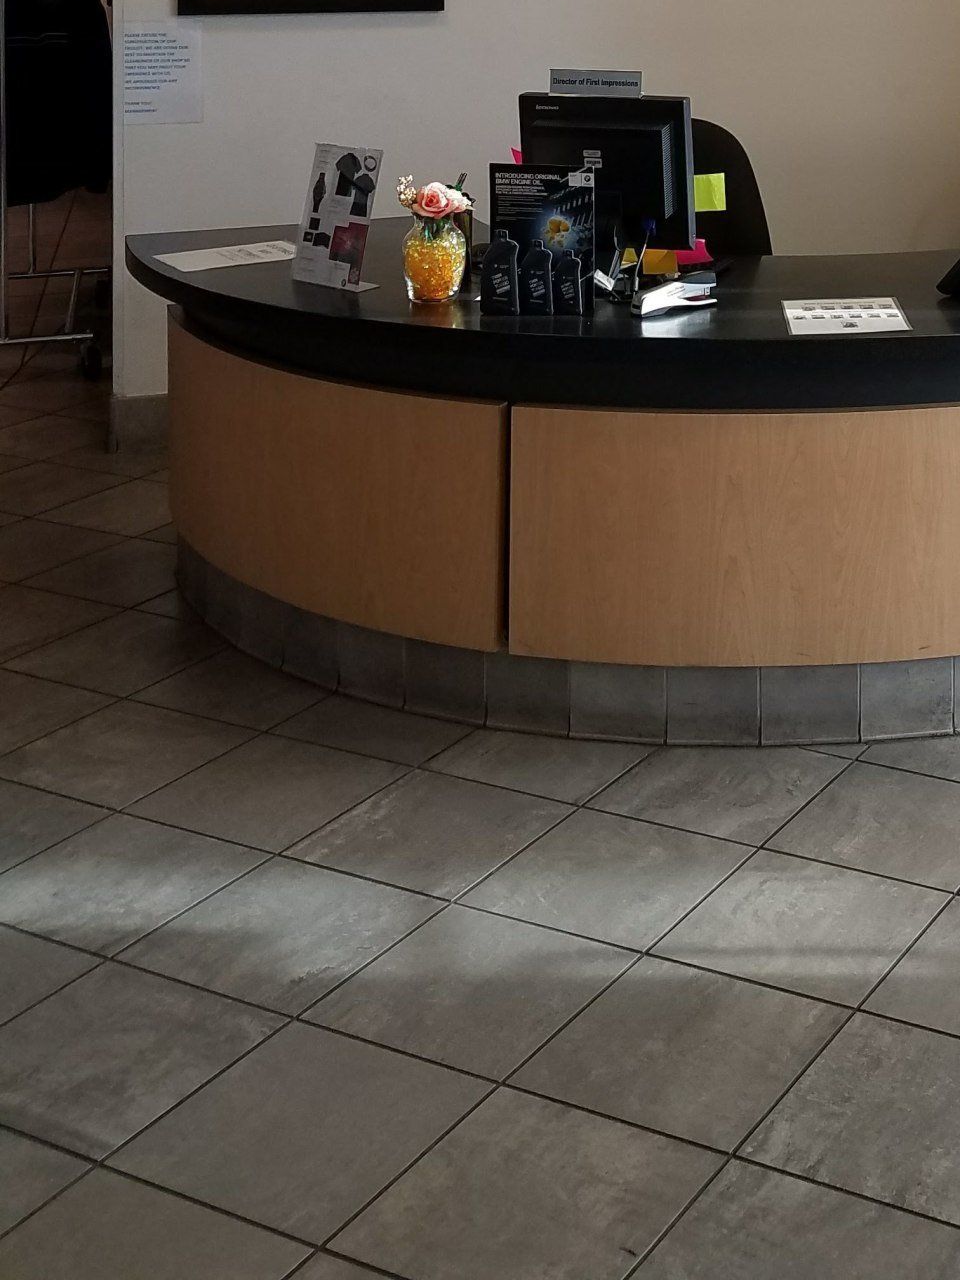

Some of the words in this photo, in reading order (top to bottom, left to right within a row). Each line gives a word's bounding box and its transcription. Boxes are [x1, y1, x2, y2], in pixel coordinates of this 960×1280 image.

[552, 77, 578, 86] Director
[578, 78, 586, 86] of
[585, 78, 600, 86] First
[601, 79, 639, 88] Impressions
